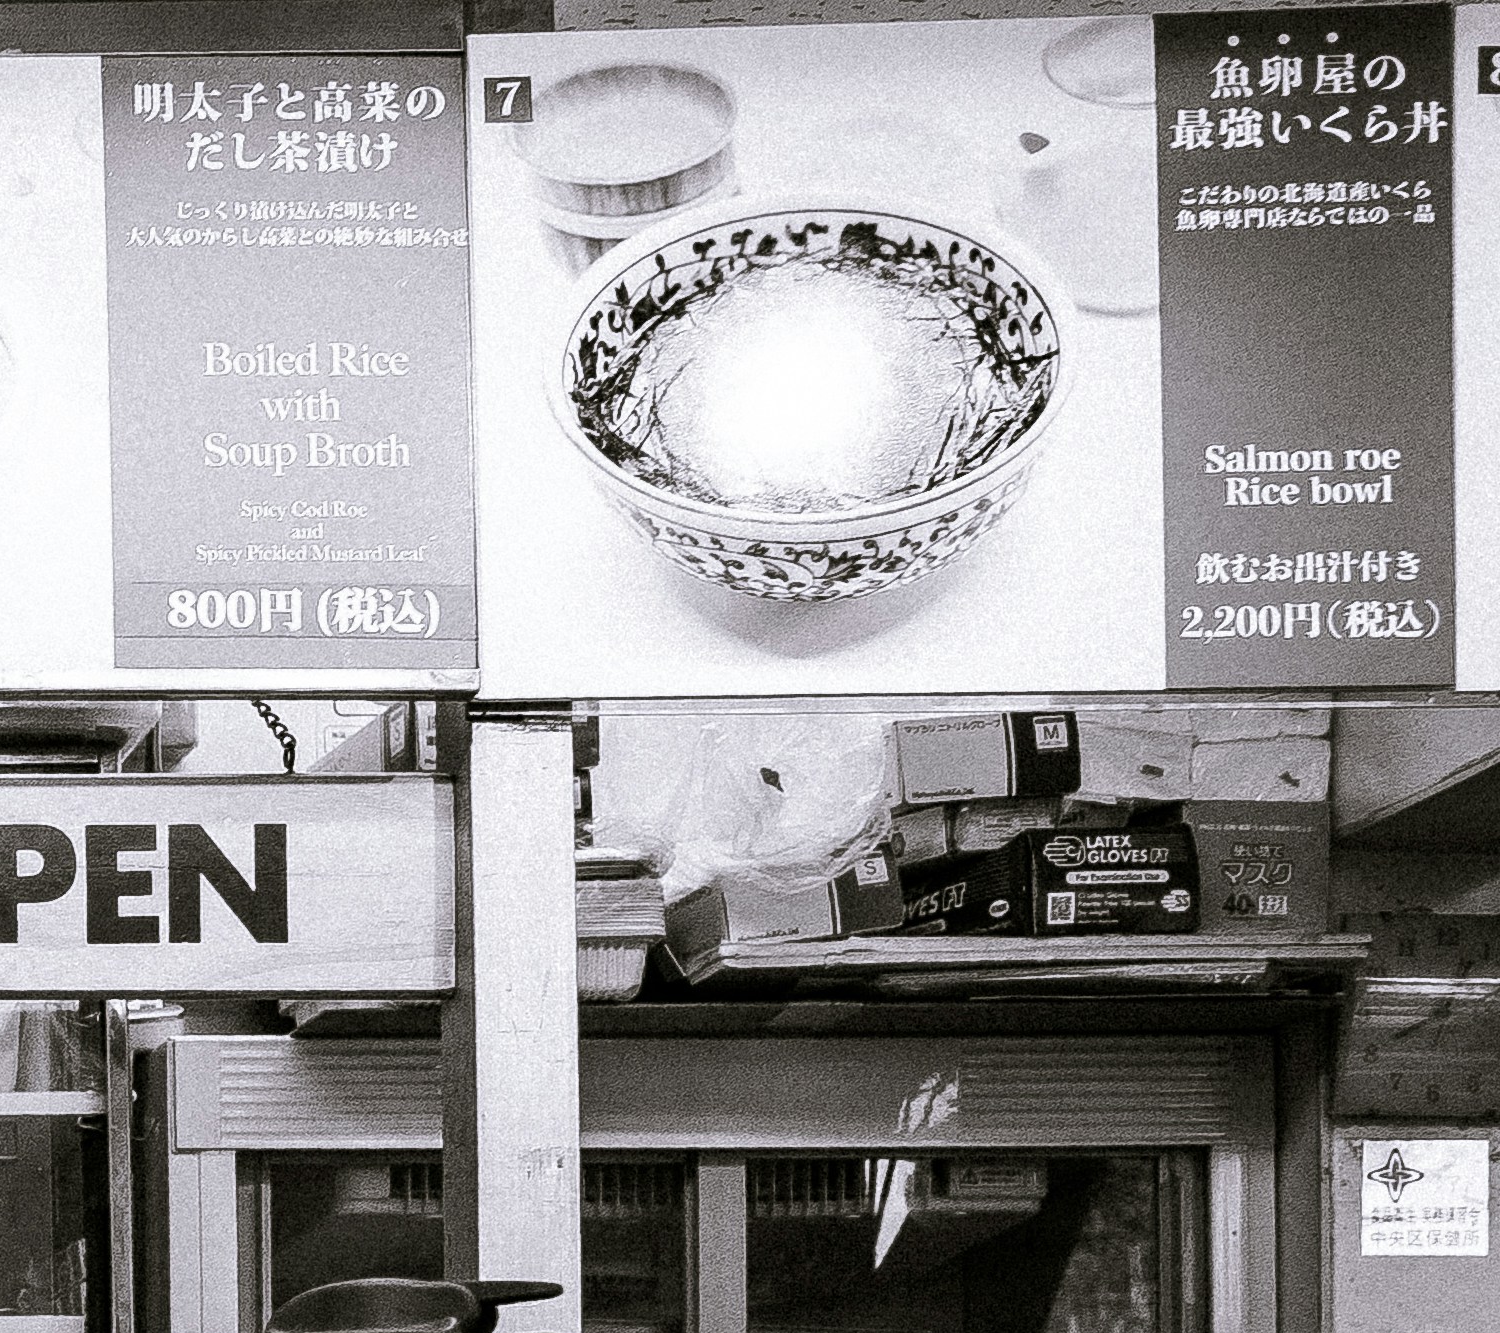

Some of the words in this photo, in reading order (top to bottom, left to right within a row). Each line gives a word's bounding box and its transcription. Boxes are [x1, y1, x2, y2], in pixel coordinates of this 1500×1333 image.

[1209, 53, 1406, 99] 魚卵屋の
[133, 81, 446, 124] 明太子と高菜の
[495, 81, 521, 116] 7
[1169, 101, 1448, 151] 最強いくら丼
[185, 130, 398, 174] だし茶漬け
[1179, 181, 1432, 206] こだわりの北海道産いくら
[1175, 204, 1435, 232] 魚卵専門店ならではの一品
[203, 342, 318, 377] Boiled
[329, 342, 410, 377] Rice
[260, 387, 341, 422] with
[204, 432, 298, 477] Soup
[305, 432, 410, 468] Broth
[1204, 444, 1334, 474] Salmon
[1343, 448, 1400, 471] roe
[1224, 476, 1300, 507] Rice
[1310, 475, 1393, 505] bowl
[290, 523, 324, 540] and
[1195, 550, 1421, 585] 飲むお出汁付き
[1086, 835, 1132, 848] LATEX
[1088, 850, 1147, 863] GLOVES
[1222, 863, 1292, 884] マスク
